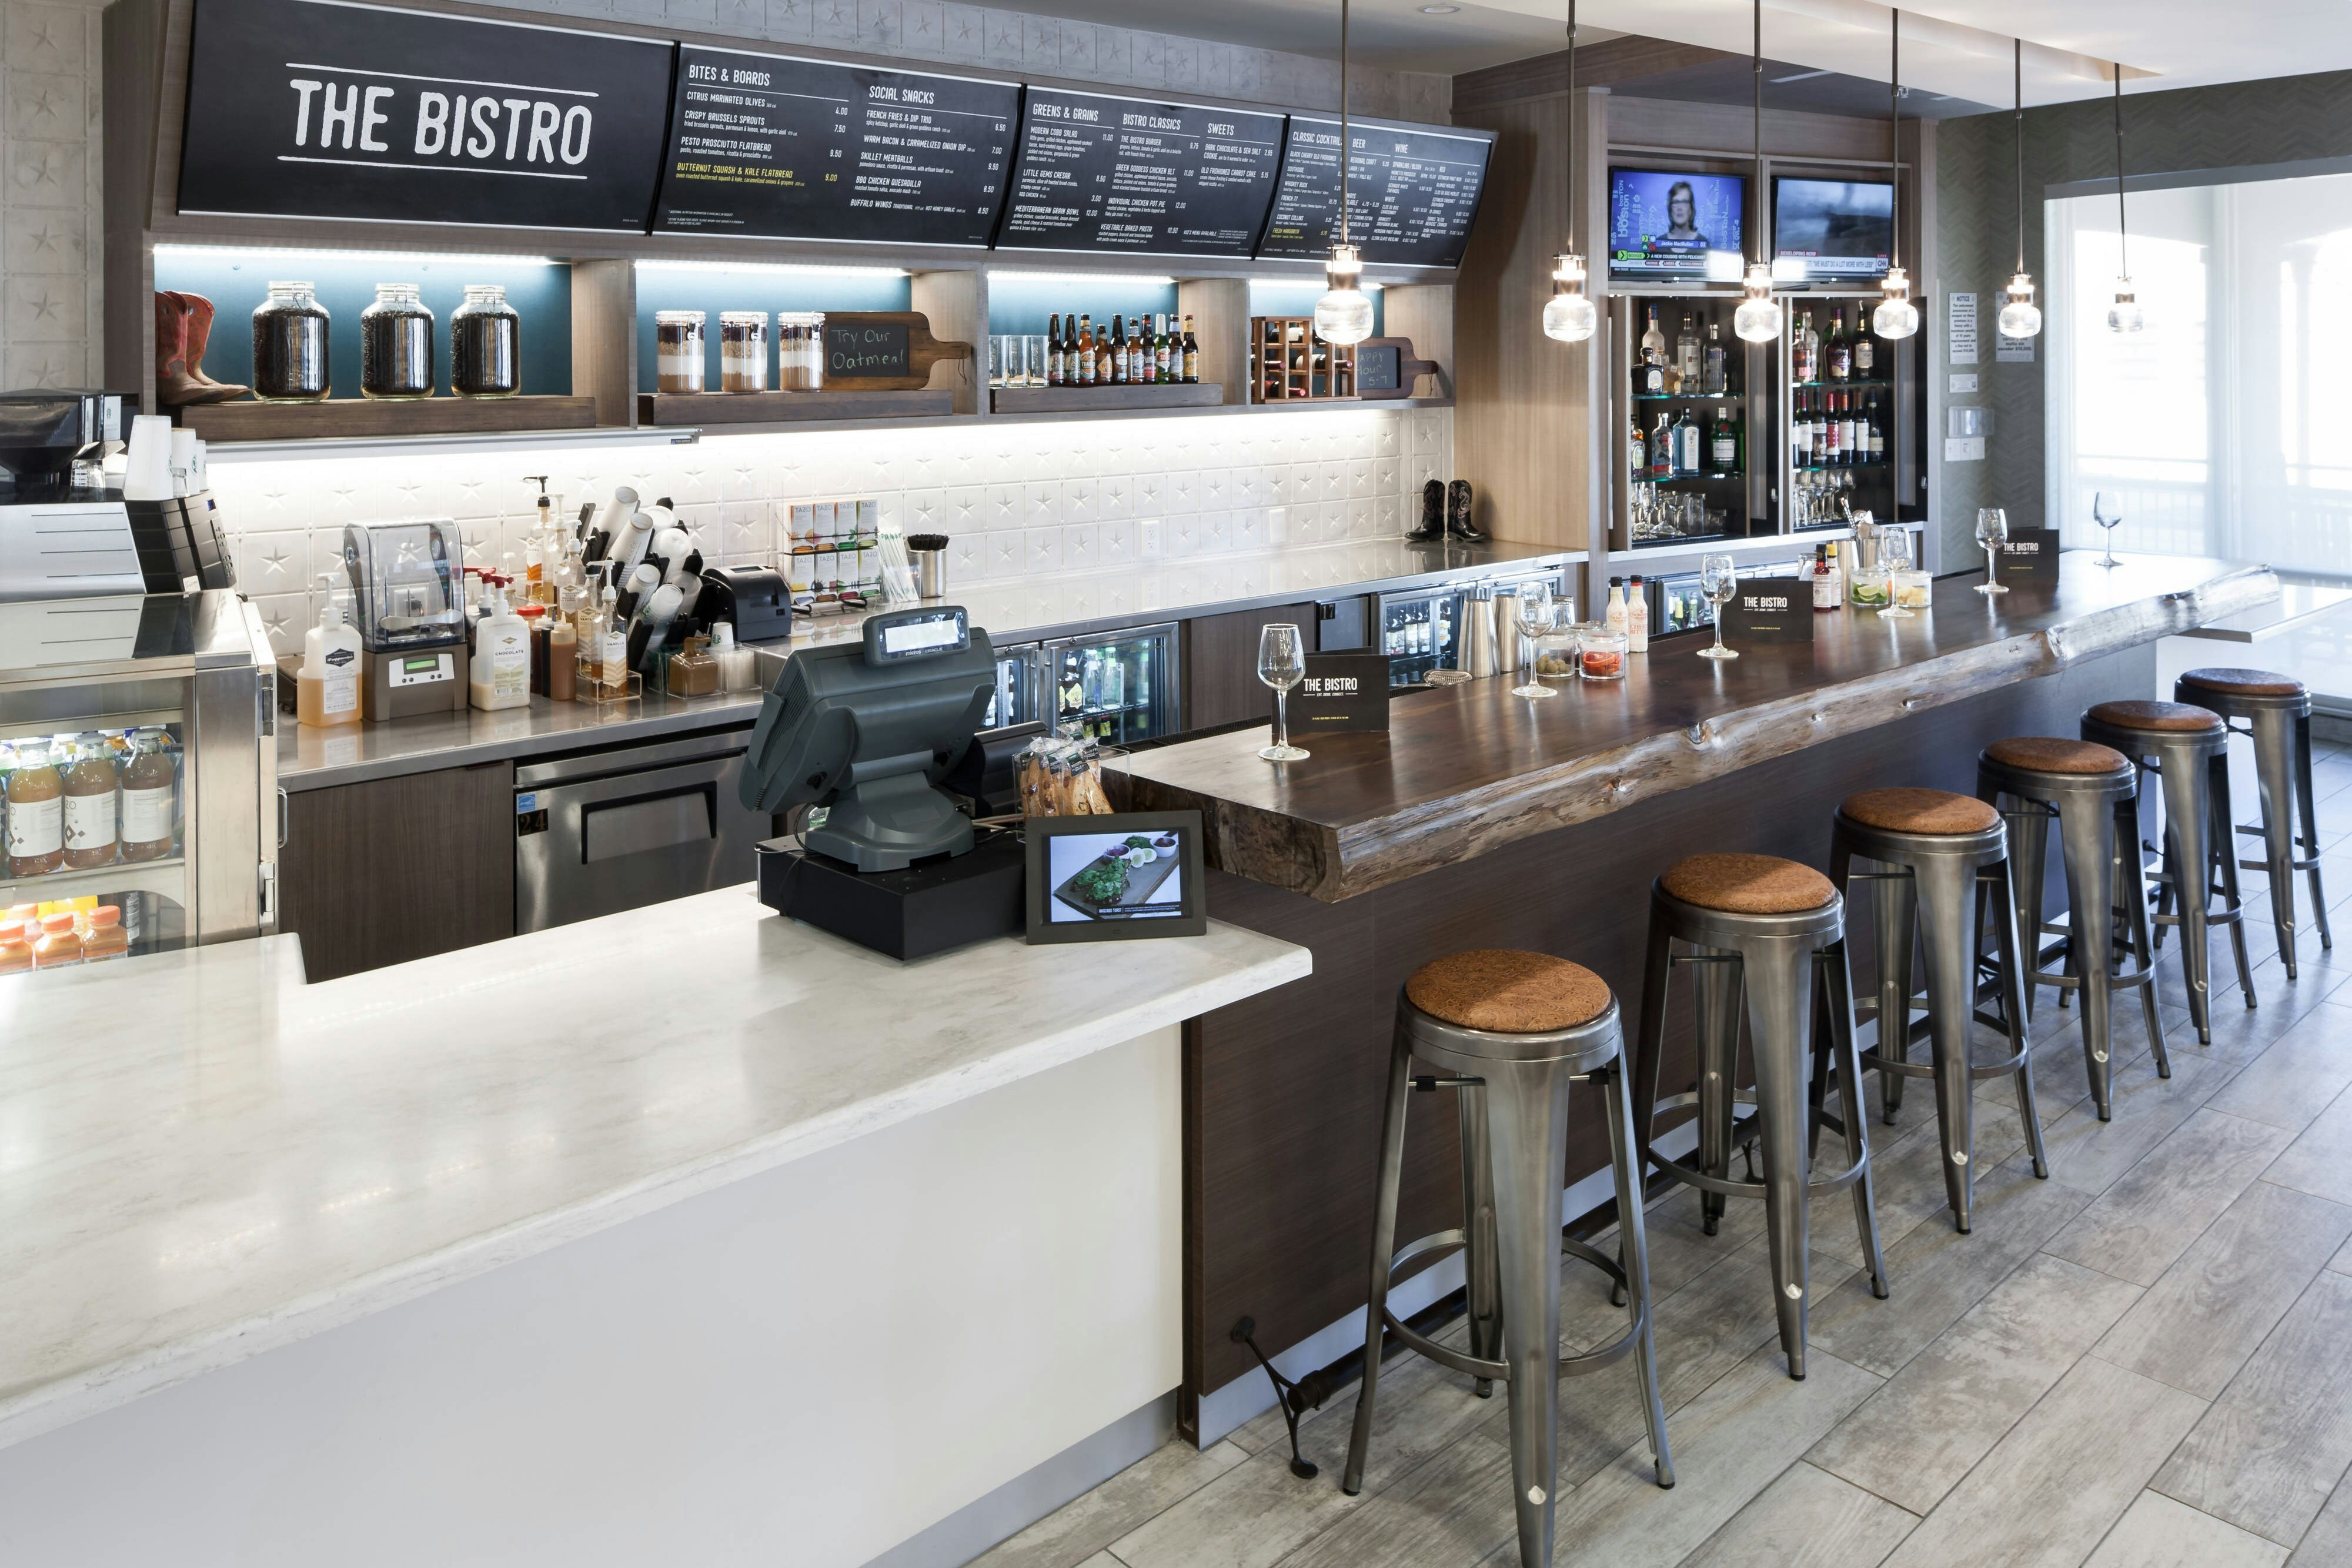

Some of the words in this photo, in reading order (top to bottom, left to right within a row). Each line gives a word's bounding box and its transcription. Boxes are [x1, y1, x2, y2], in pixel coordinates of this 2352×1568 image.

[689, 65, 717, 81] BITES
[720, 68, 729, 82] &
[733, 69, 770, 86] BOARDS
[687, 91, 709, 102] CITRUS
[710, 93, 743, 105] MARINATED
[745, 97, 766, 107] OLIVES
[869, 85, 898, 101] SOCIAL
[902, 89, 934, 105] SNACKS
[835, 106, 848, 116] 4.00
[866, 109, 887, 119] FRENCH
[888, 112, 903, 121] FRIES
[904, 113, 909, 122] &
[910, 114, 919, 122] DIP
[920, 115, 932, 124] TRIO
[1033, 103, 1061, 118] GREENS
[1063, 106, 1070, 119] &
[1073, 108, 1099, 122] GRAINS
[289, 79, 395, 152] THE
[414, 92, 593, 165] BISTRO
[684, 110, 706, 120] CRISPY
[707, 112, 738, 123] BRUSSELS
[739, 115, 765, 126] SPROUTS
[1122, 113, 1147, 127] BISTRO
[1149, 116, 1181, 131] CLASSICS
[834, 124, 846, 133] 7.50
[995, 123, 1006, 132] 6.50
[1030, 126, 1050, 135] MODERN
[1050, 128, 1063, 136] COBB
[1063, 129, 1078, 138] SALAD
[1207, 122, 1235, 136] SWEETS
[681, 136, 700, 146] PESTO
[701, 138, 738, 149] PROSCIUTTO
[739, 141, 771, 152] FLATBREAD
[864, 135, 881, 143] WARM
[881, 136, 900, 145] BACON
[900, 138, 906, 146] &
[907, 138, 941, 149] CARAMELIZED
[942, 142, 957, 151] ONION
[1102, 133, 1114, 142] 11.00
[1292, 131, 1315, 143] CLASSIC
[1316, 133, 1342, 146] COCKTAIL
[1352, 138, 1366, 149] BEER
[830, 149, 842, 158] 9.50
[991, 146, 1003, 155] 7.00
[1395, 143, 1408, 154] WINE
[860, 152, 883, 161] SKILLET
[883, 153, 913, 163] MEATBALLS
[677, 162, 711, 172] BUTTERNUT
[713, 165, 736, 174] SQUASH
[737, 166, 743, 175] &
[744, 167, 760, 176] KALE
[761, 168, 793, 179] FLATBREAD
[988, 162, 999, 170] 9.50
[825, 173, 838, 182] 9.00
[1023, 169, 1039, 177] LITTLE
[1040, 170, 1053, 178] GEMS
[1053, 171, 1071, 179] CAESAR
[856, 175, 867, 184] BBQ
[868, 176, 890, 185] CHICKEN
[891, 178, 921, 188] QUESADILLA
[850, 199, 874, 208] BUFFALO
[1015, 205, 1052, 213] MEDITERRANEAN
[831, 330, 858, 350] Try
[865, 329, 890, 343] Our
[833, 349, 903, 369] Oatmeal
[1359, 352, 1384, 363] APPY
[2004, 543, 2015, 551] THE
[2016, 543, 2039, 551] BISTRO
[1744, 597, 1758, 607] THE
[1760, 597, 1788, 608] BISTRO
[1322, 604, 1334, 619] 17
[1303, 678, 1321, 691] THE
[1325, 677, 1358, 691] BISTRO
[520, 810, 546, 834] 24
